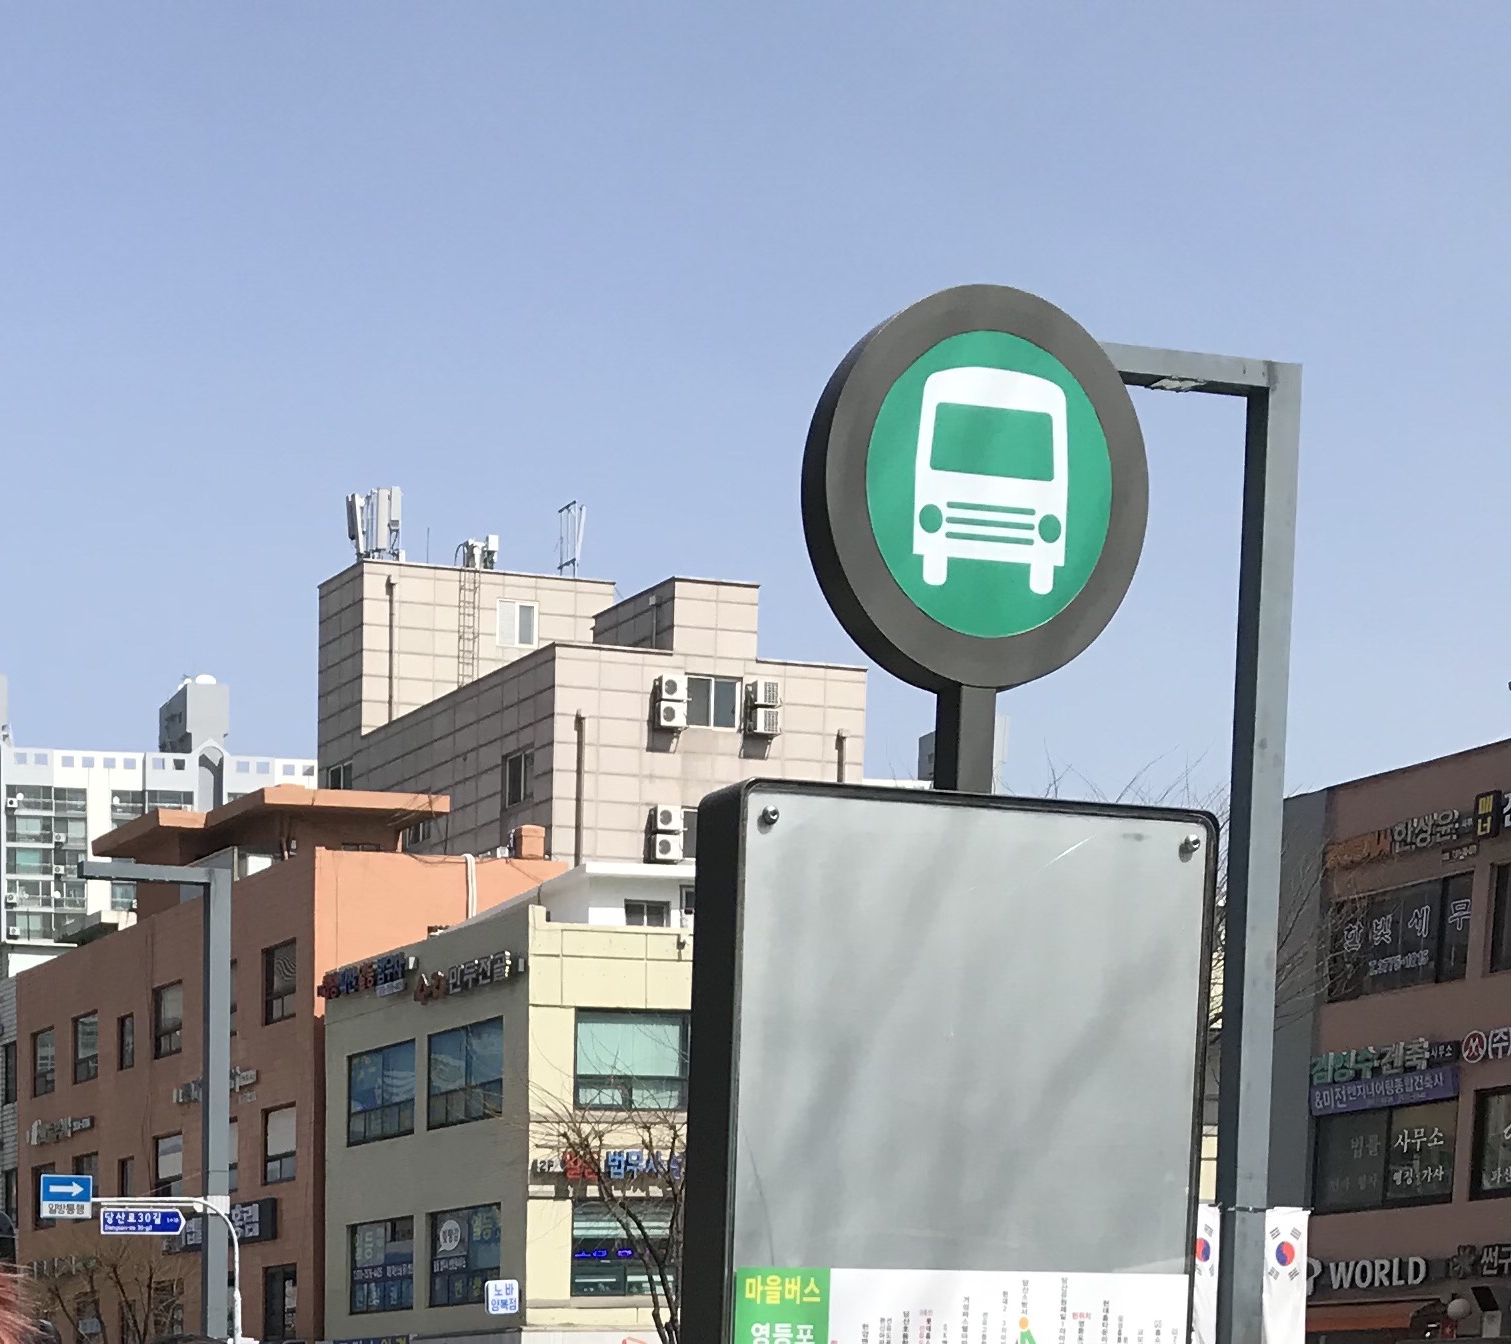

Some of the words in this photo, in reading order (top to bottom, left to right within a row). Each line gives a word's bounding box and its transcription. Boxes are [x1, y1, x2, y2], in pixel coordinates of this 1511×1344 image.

[448, 950, 511, 995] 만두전골
[1394, 1127, 1445, 1153] 사무소
[48, 1204, 85, 1215] 일방통행
[104, 1212, 162, 1224] 당산로30길
[1329, 1256, 1428, 1291] WORLD
[744, 1275, 821, 1305] 마을버스
[491, 1299, 517, 1312] 양복점
